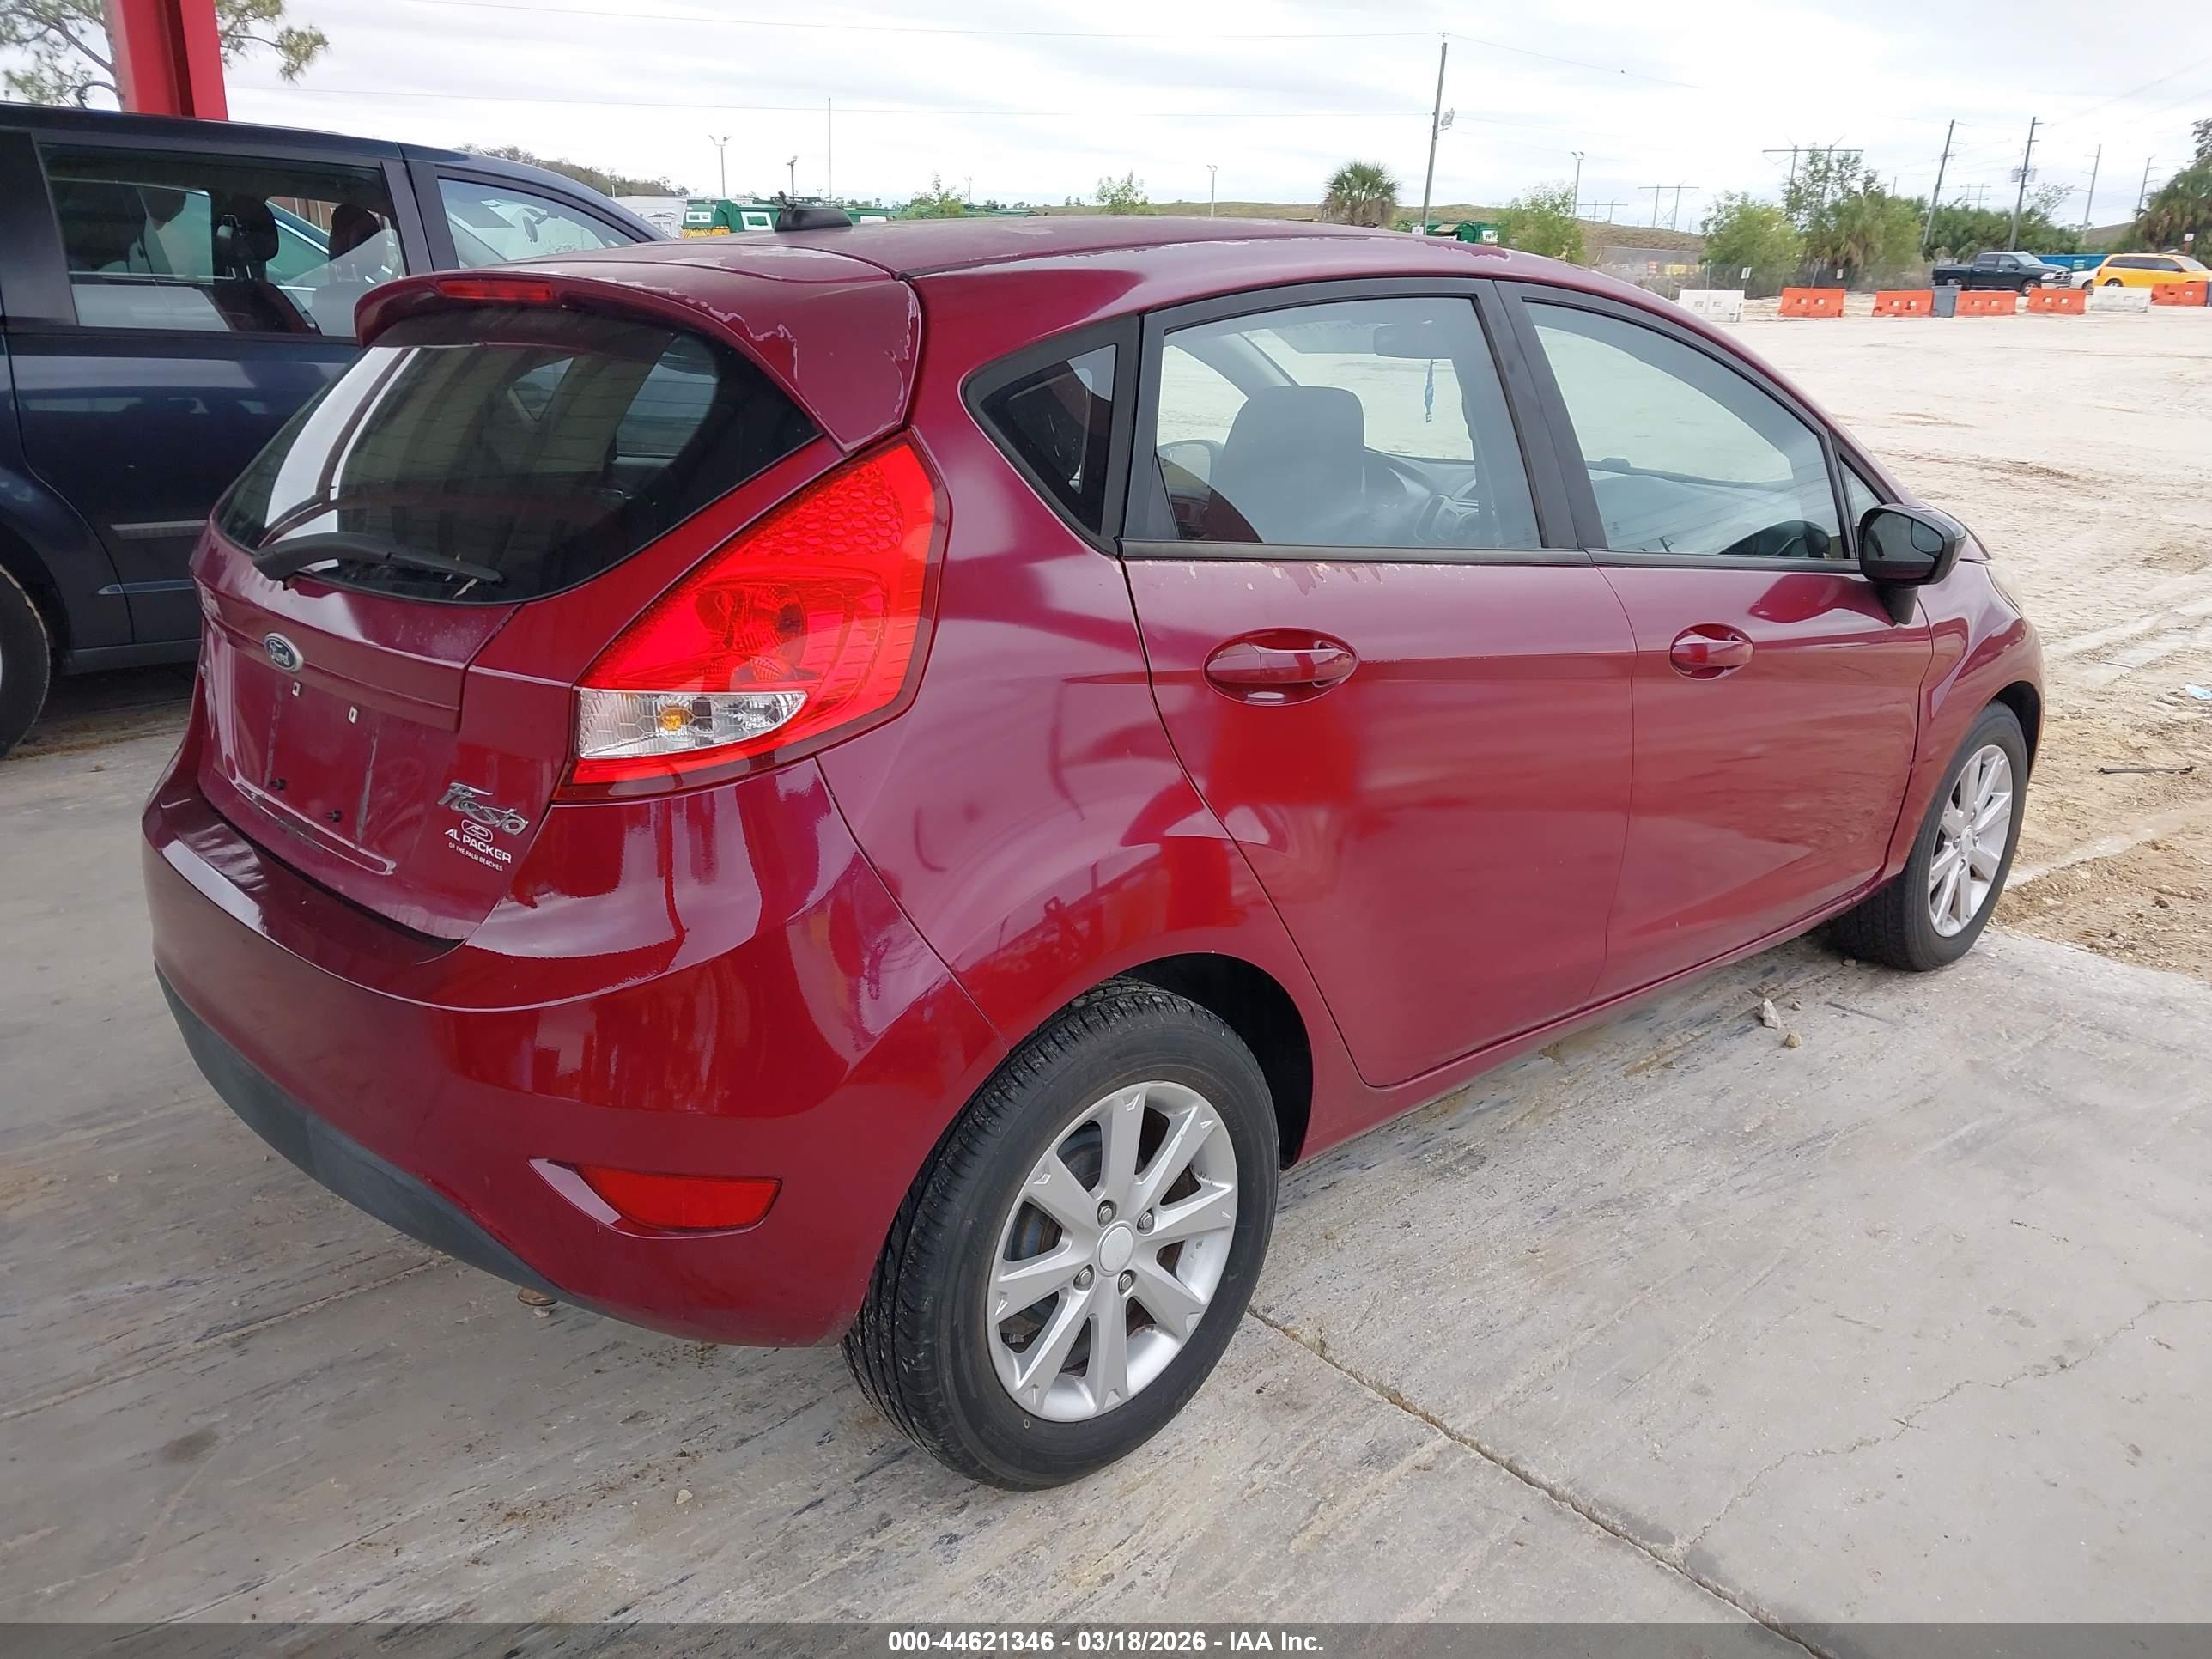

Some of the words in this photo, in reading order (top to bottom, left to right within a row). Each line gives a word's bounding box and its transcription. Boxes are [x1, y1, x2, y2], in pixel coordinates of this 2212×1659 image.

[438, 782, 529, 836] Fiesta
[444, 828, 461, 842] AL
[462, 836, 512, 863] PACKER
[456, 845, 465, 854] THE
[465, 851, 479, 860] PALM
[479, 856, 503, 871] BEACHES
